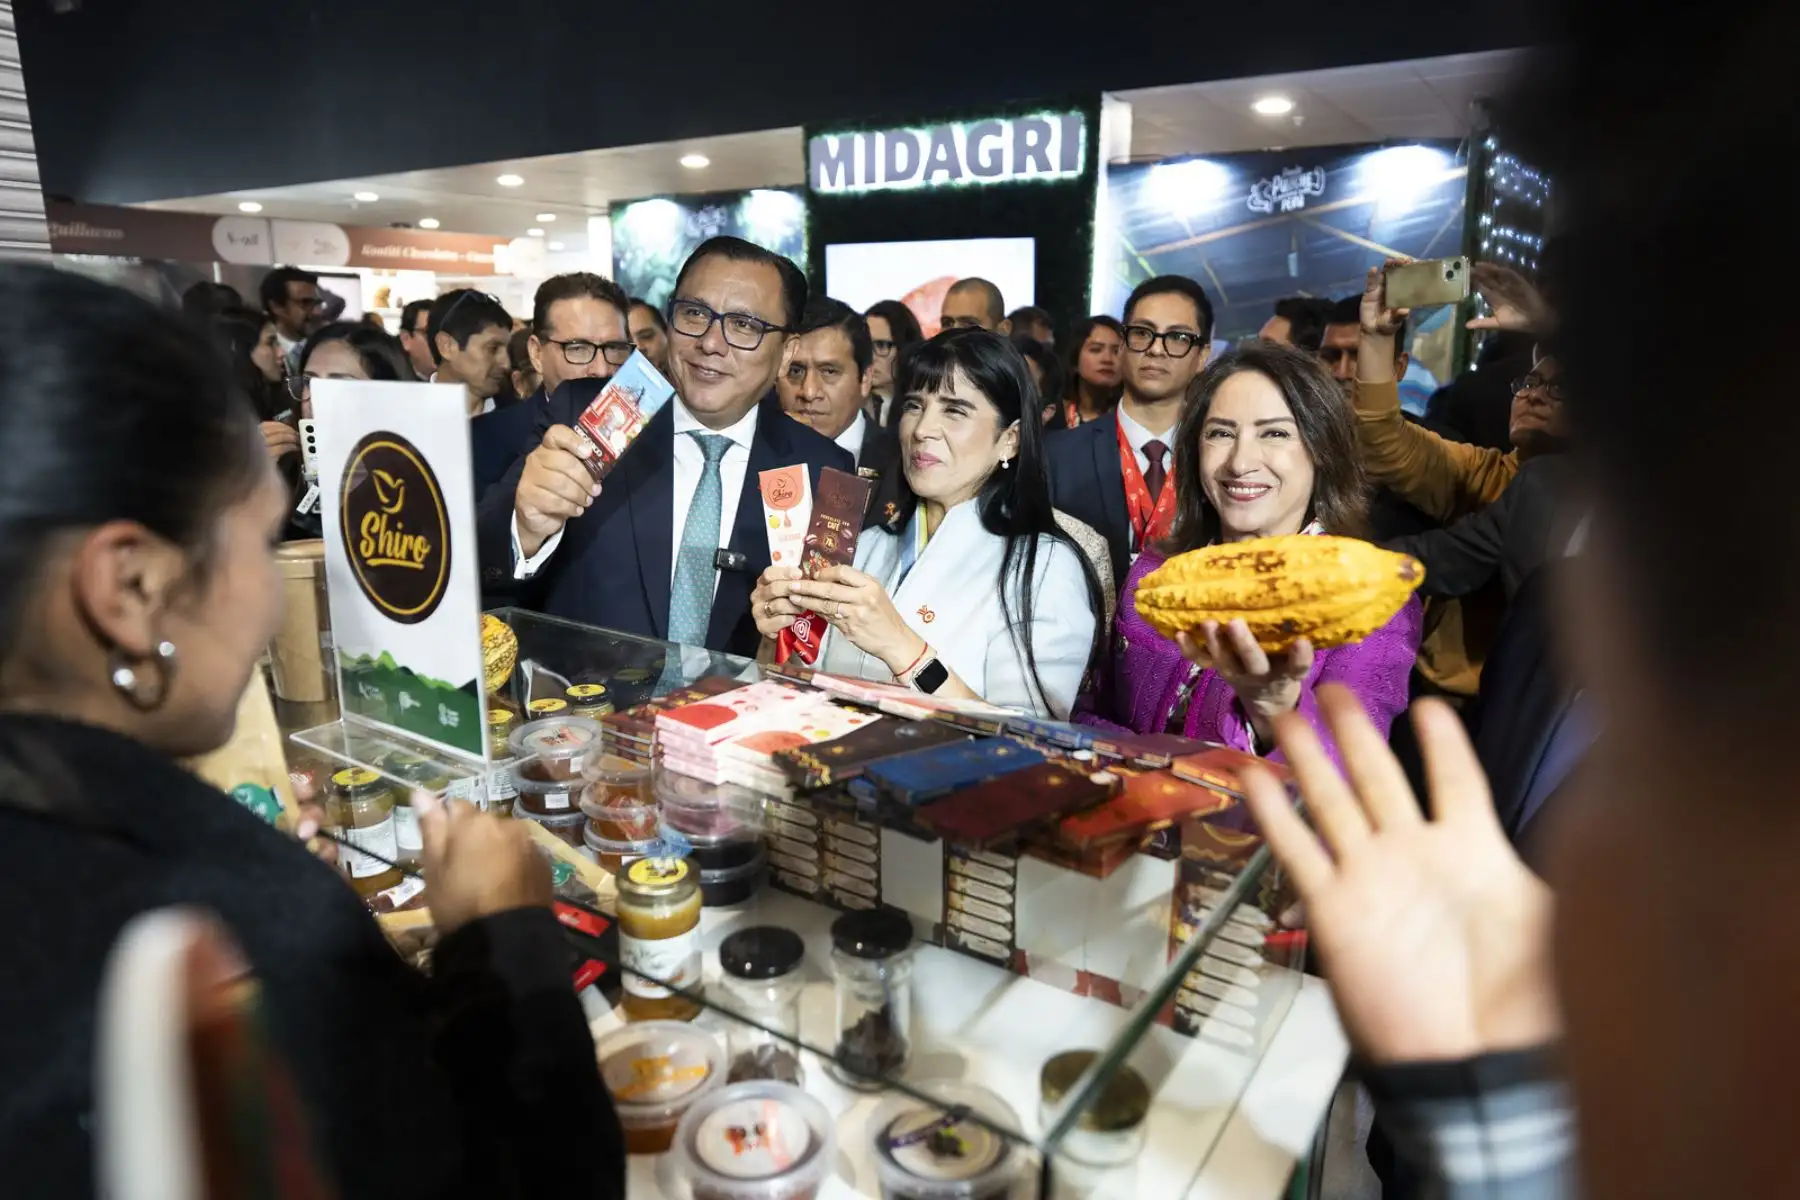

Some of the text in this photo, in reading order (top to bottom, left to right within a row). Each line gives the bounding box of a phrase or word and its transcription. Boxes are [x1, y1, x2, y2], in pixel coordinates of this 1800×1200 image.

[809, 114, 1082, 191] MIDAGRI
[773, 488, 793, 500] Shiro
[360, 510, 432, 562] Shiro
